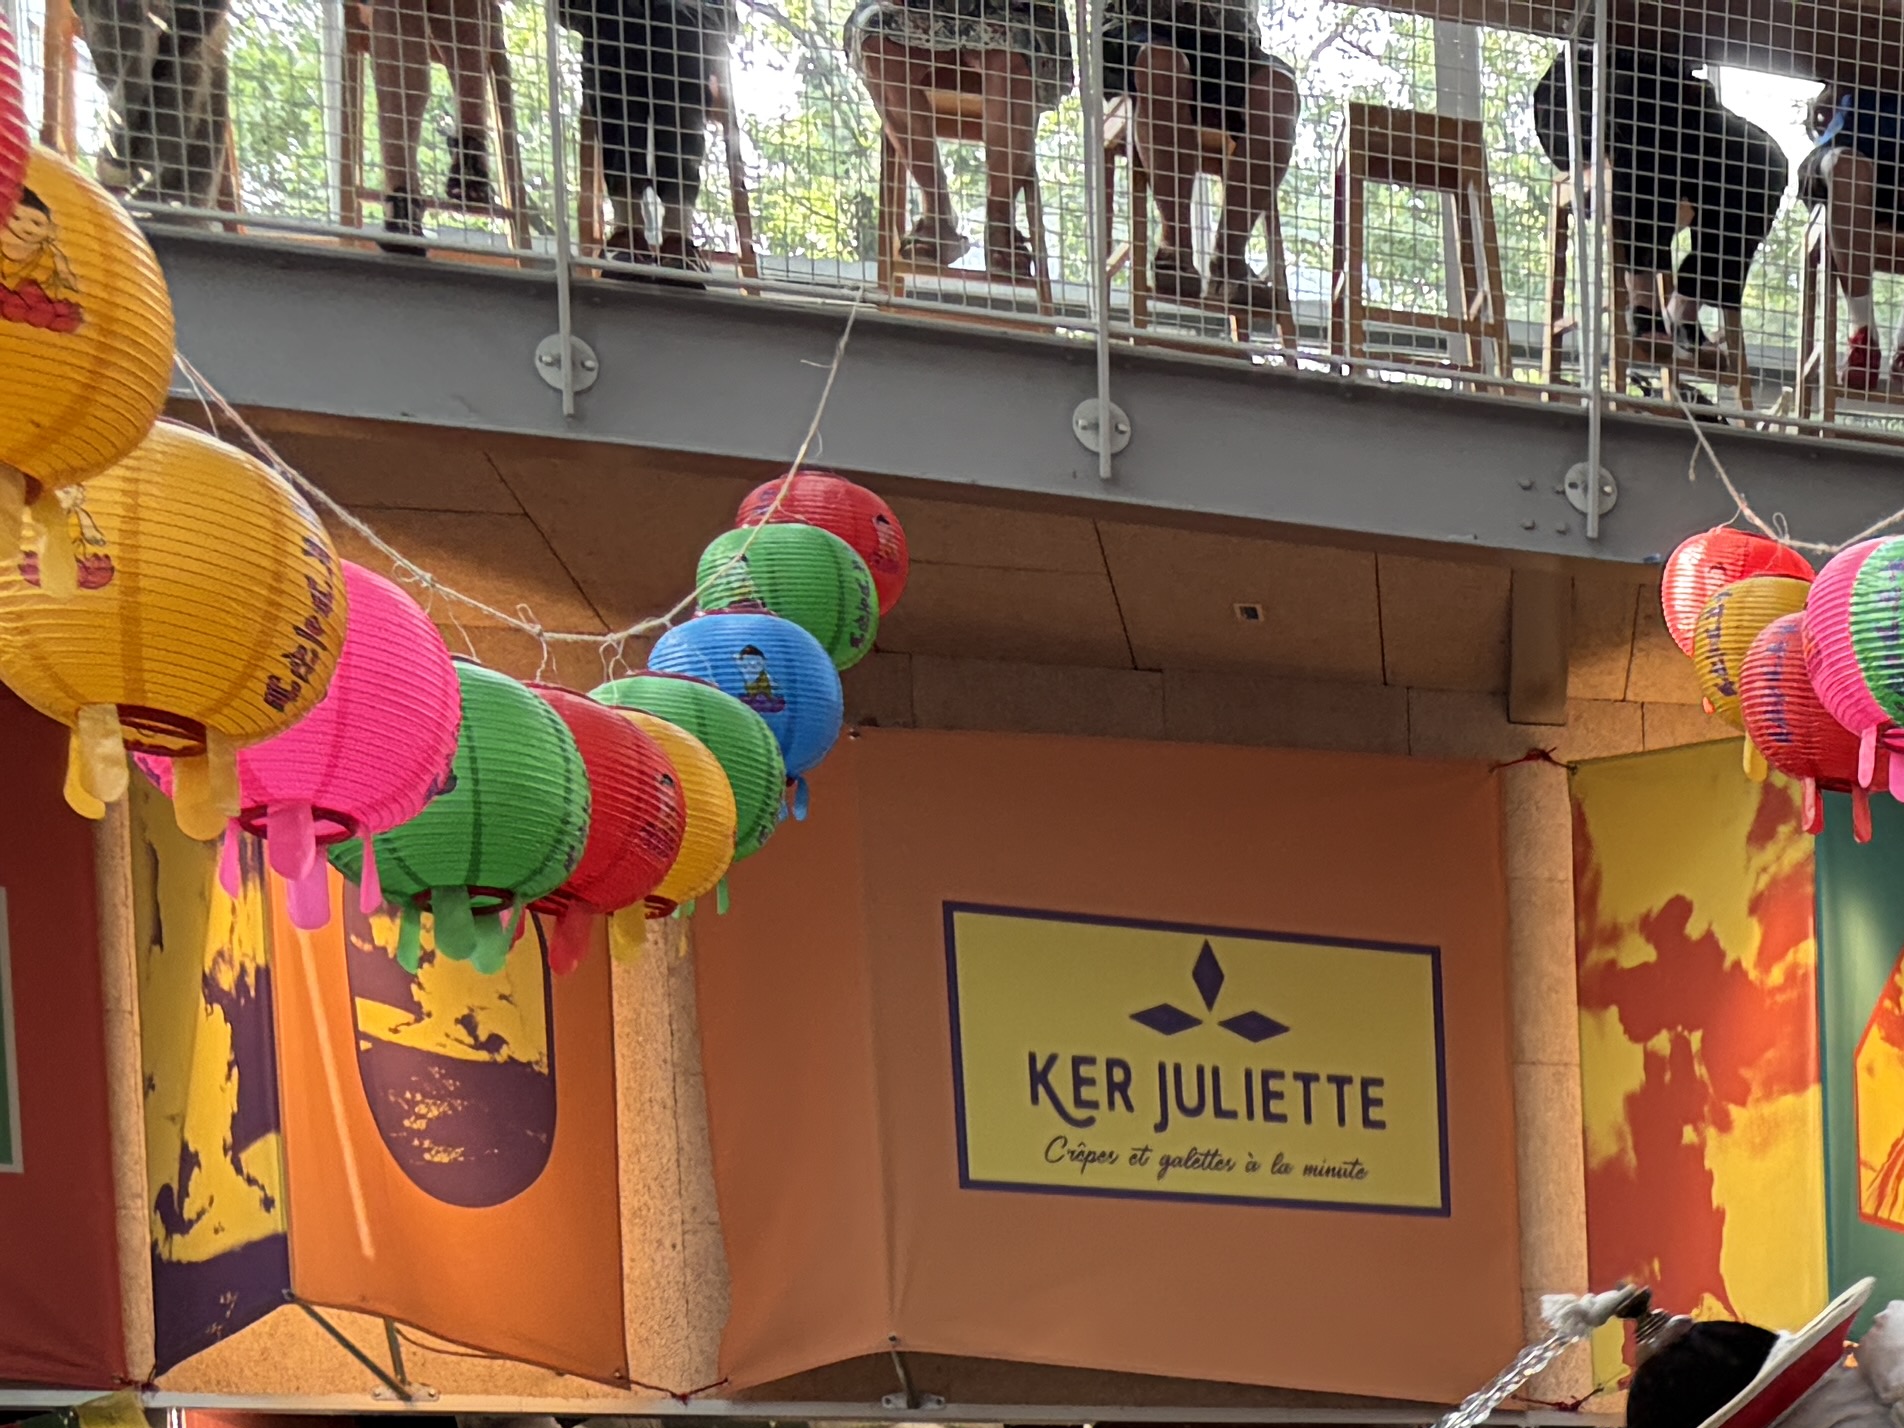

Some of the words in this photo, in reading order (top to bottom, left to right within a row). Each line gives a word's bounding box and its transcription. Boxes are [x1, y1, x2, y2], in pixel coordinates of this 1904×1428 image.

[1028, 1050, 1135, 1129] KER
[1153, 1060, 1388, 1134] JULIETTE
[1043, 1135, 1119, 1175] Crêpes
[1128, 1145, 1153, 1167] et
[1158, 1146, 1237, 1181] galettes
[1245, 1152, 1261, 1174] à
[1271, 1151, 1293, 1176] la
[1302, 1158, 1369, 1181] minute
